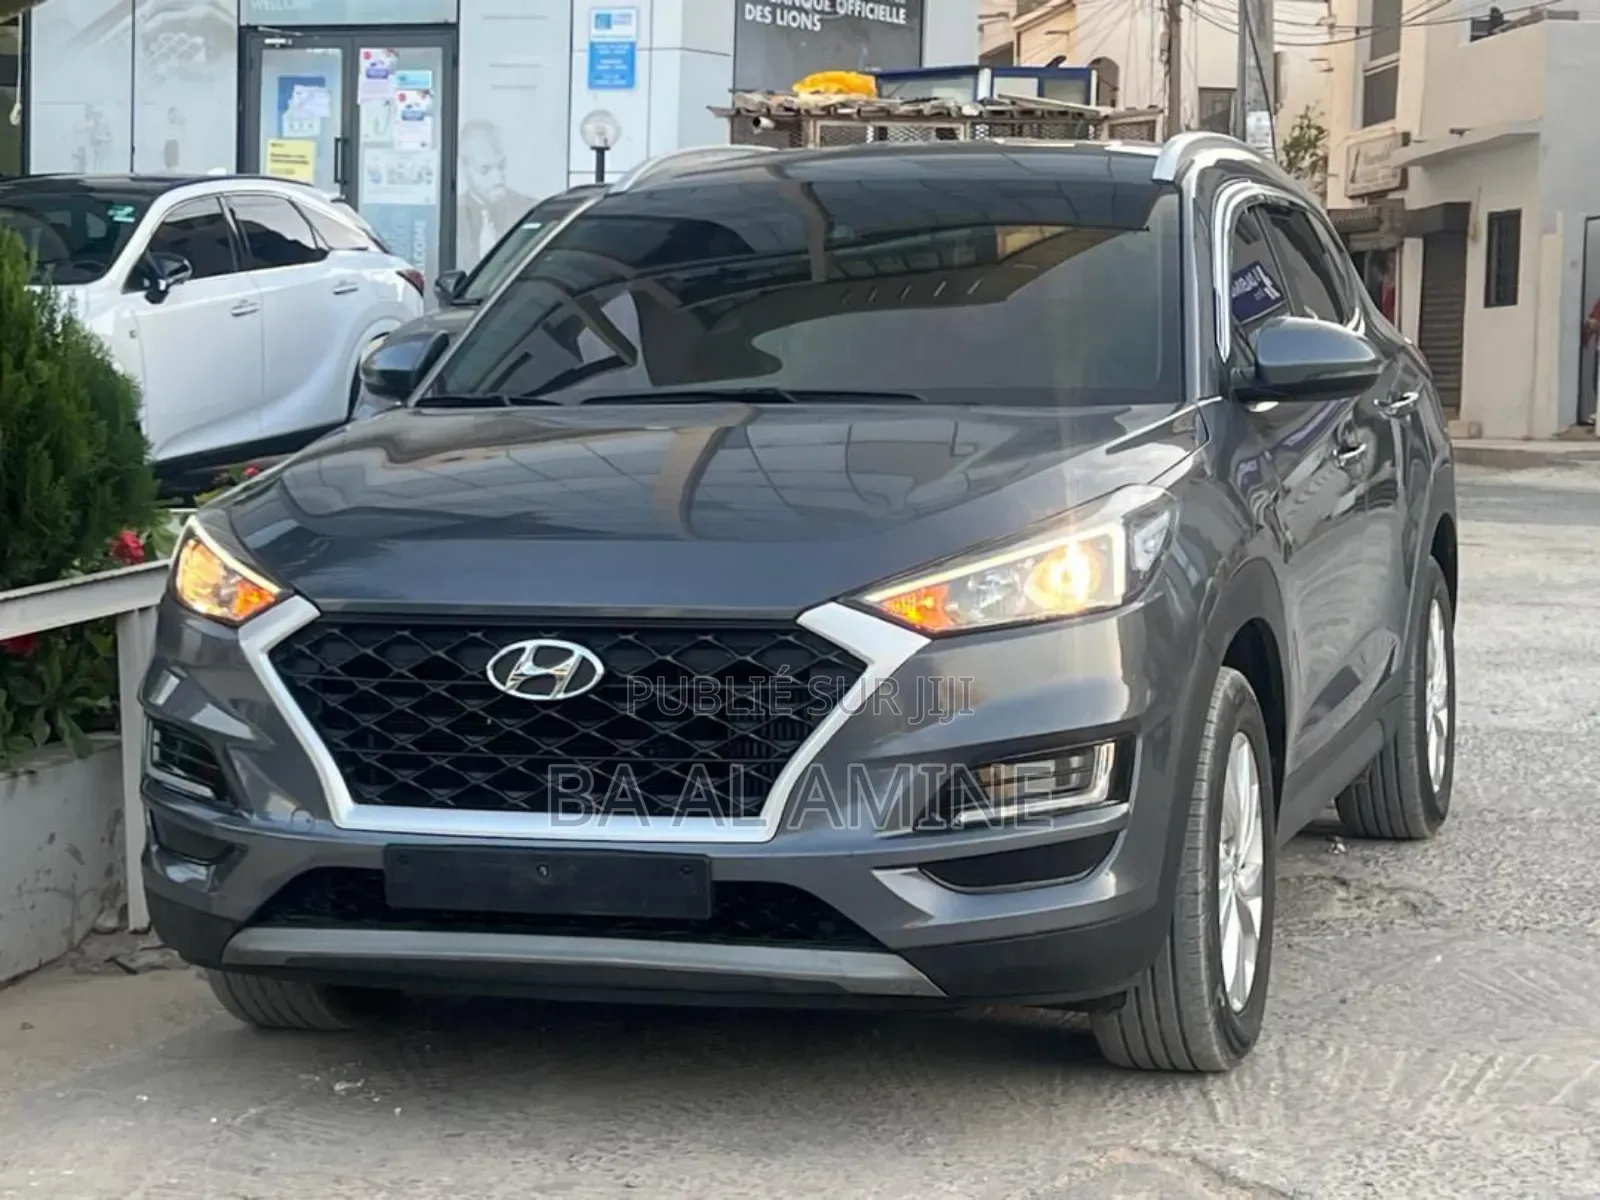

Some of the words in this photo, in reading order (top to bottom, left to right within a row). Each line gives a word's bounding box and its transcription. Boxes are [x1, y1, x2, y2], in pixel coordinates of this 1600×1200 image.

[744, 3, 773, 25] DES
[776, 7, 822, 32] LIONS
[836, 0, 907, 25] OFFICIELLE
